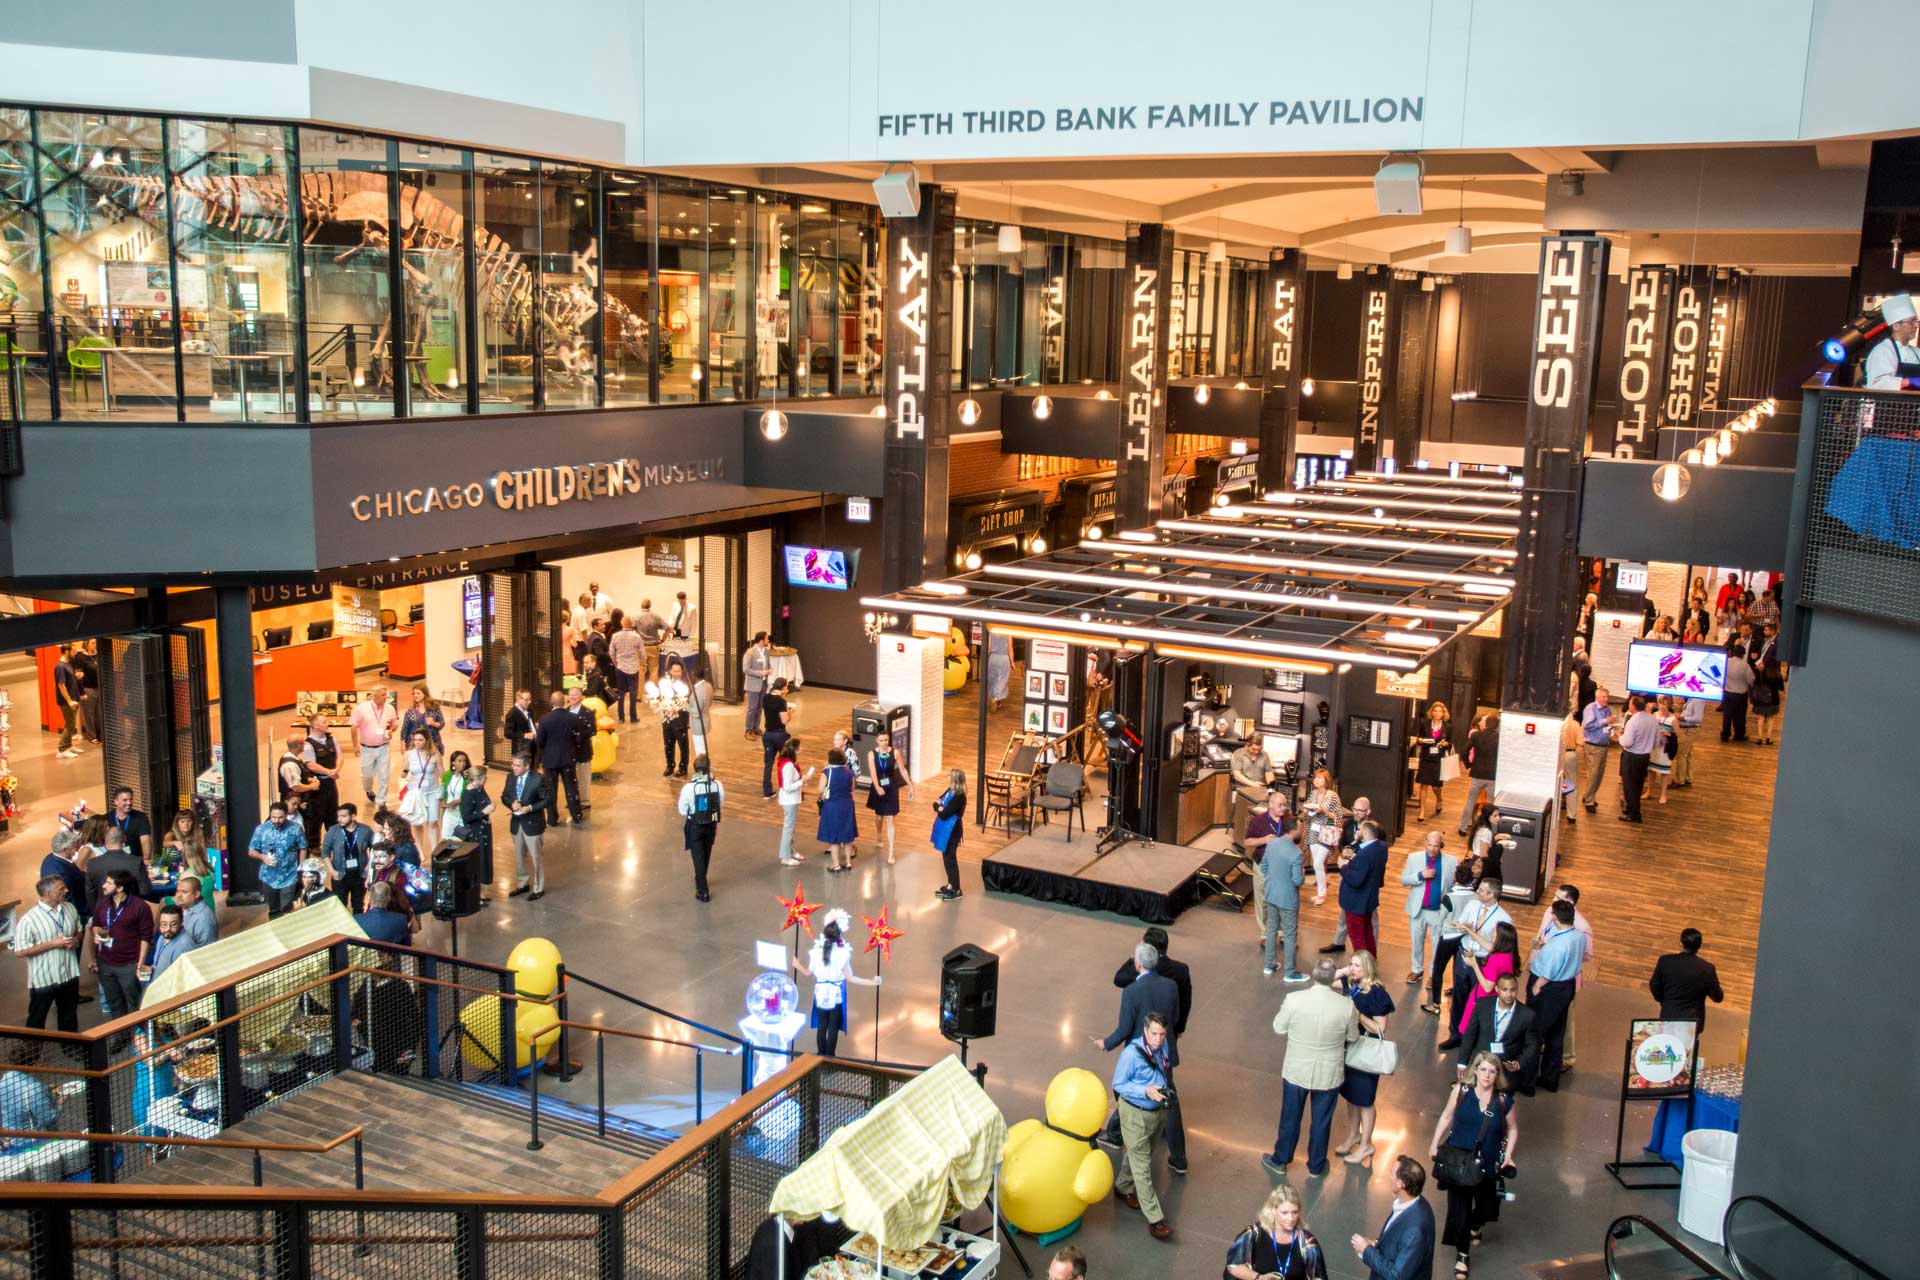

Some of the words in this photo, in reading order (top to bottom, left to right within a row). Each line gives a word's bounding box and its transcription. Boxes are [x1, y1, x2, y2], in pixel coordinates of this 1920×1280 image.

[879, 113, 953, 137] FIFTH
[963, 109, 1045, 133] THIRD
[1056, 106, 1137, 131] BANK
[1147, 102, 1259, 128] FAMILY
[1269, 97, 1423, 125] PAVILION
[897, 238, 928, 440] PLAY
[1127, 264, 1157, 461] LEARN
[1272, 280, 1295, 371] EAT
[1360, 291, 1387, 444] INSPIRE
[1534, 241, 1584, 407] SEE
[1667, 287, 1701, 421] SHOP
[1702, 297, 1727, 411] MEET
[352, 482, 484, 522] CHICAGO
[494, 458, 641, 511] CHILDREN'S
[644, 457, 726, 487] MUSEUM
[850, 505, 867, 516] EXIT
[1003, 508, 1025, 528] SHOP
[1620, 571, 1644, 585] EXIT
